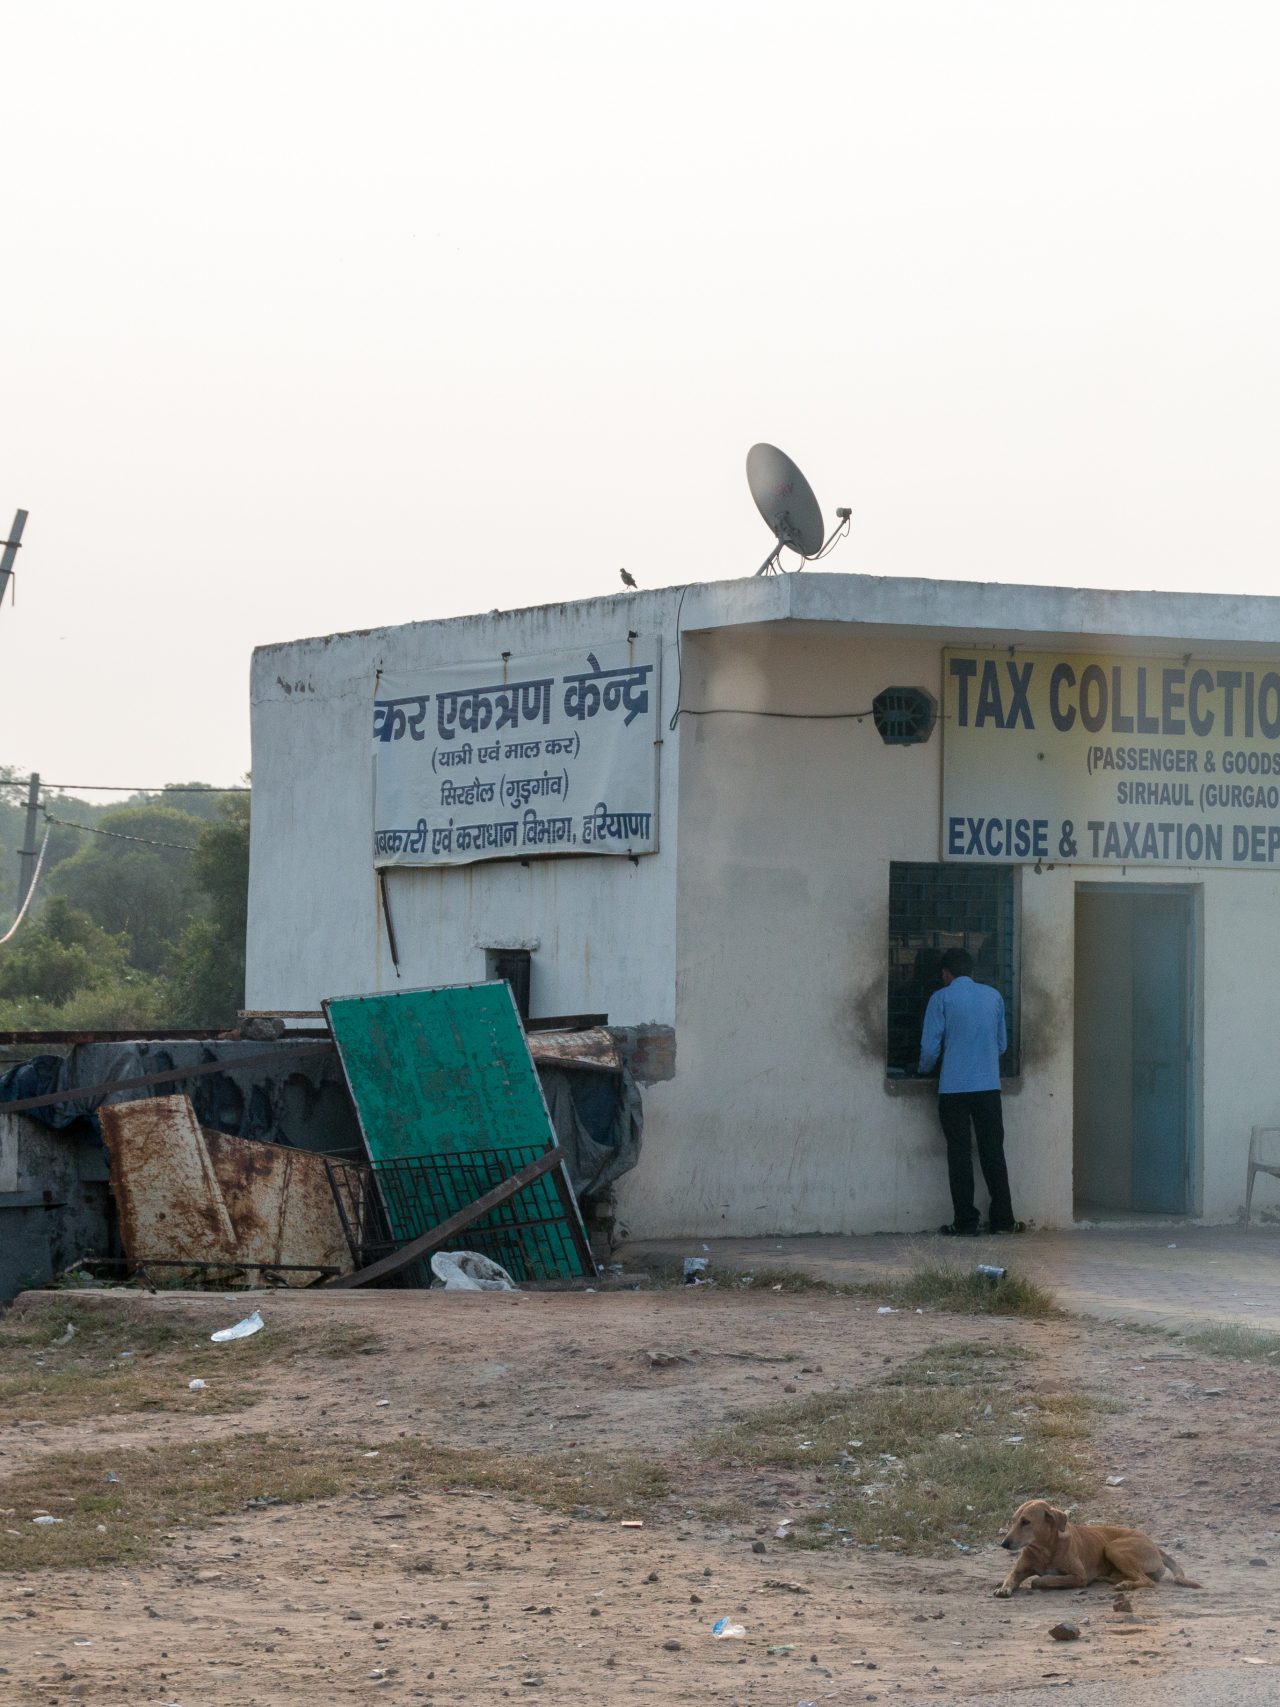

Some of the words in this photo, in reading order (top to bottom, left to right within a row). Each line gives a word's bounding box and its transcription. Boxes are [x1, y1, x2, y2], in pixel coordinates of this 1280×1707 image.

[949, 658, 1036, 730] TAX
[373, 695, 430, 742] कर
[431, 742, 473, 774] (यात्री
[477, 740, 502, 763] एवं
[504, 741, 542, 759] माल
[545, 730, 580, 760] कर)
[1087, 745, 1198, 775] (PASSENGER
[1203, 752, 1216, 774] &
[1117, 781, 1194, 807] SIRHAUL
[431, 817, 453, 855] एवं
[522, 808, 576, 846] विभाग,
[582, 801, 652, 844] हरियाणा
[948, 816, 1049, 858] EXCISE
[1059, 820, 1078, 858] &
[1087, 820, 1223, 863] TAXATION
